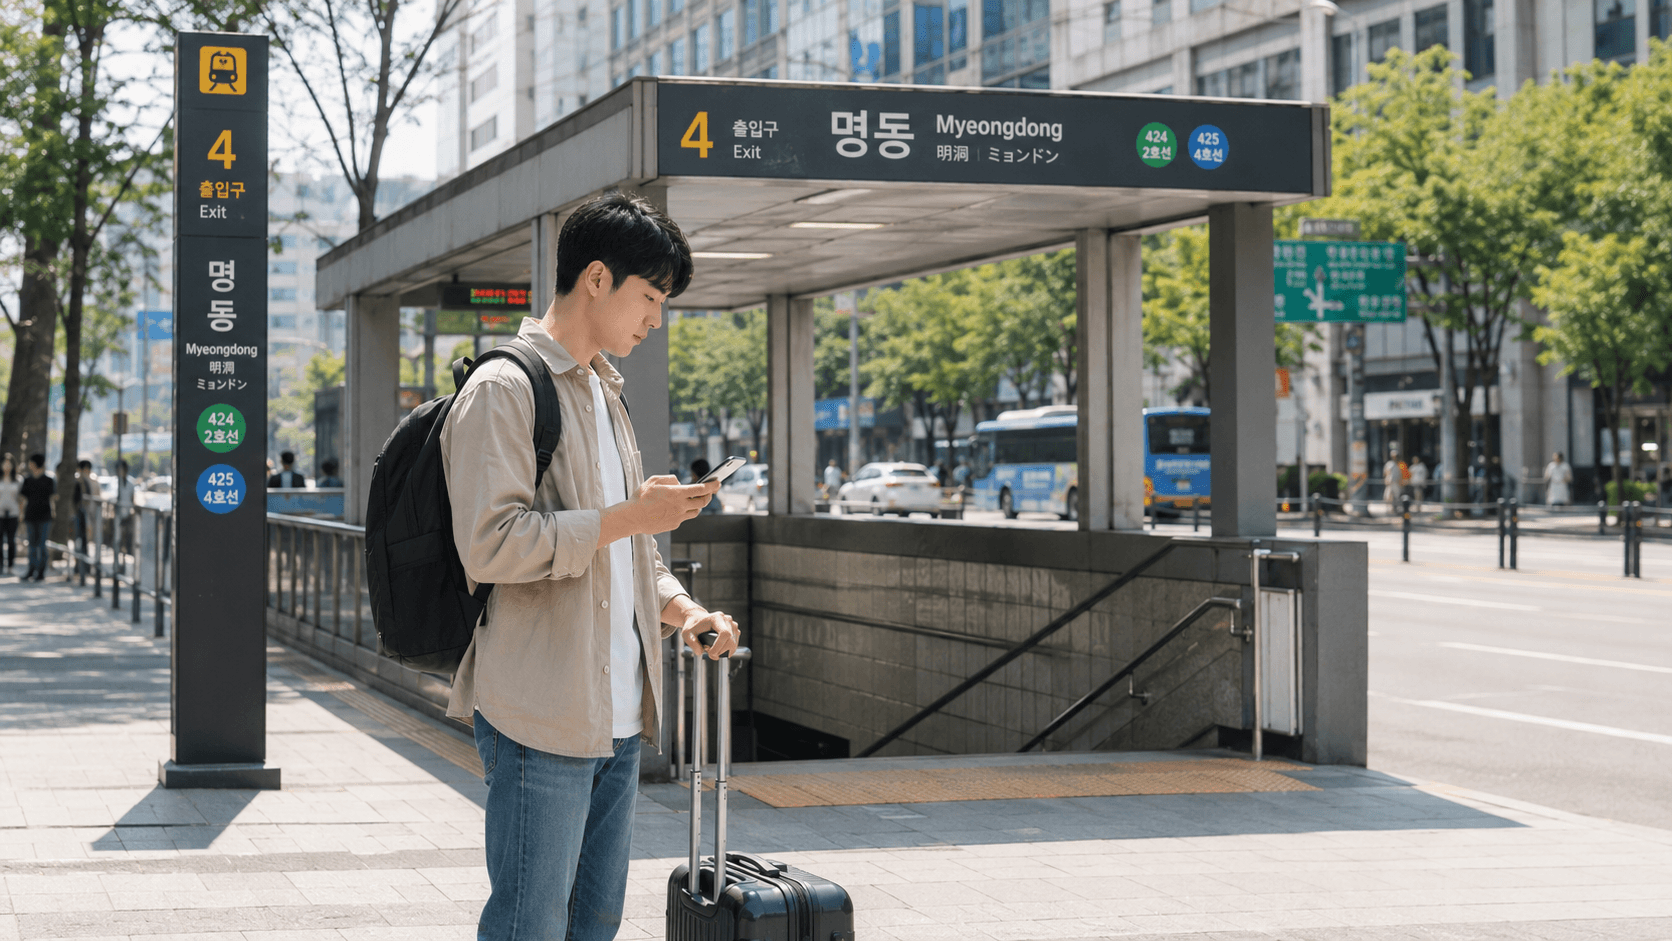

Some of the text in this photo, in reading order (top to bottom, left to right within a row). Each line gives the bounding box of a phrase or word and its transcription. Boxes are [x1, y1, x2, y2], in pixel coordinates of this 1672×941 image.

[680, 111, 714, 158] 4
[732, 119, 779, 138] 출입구
[831, 109, 915, 160] 명동
[936, 114, 1063, 142] Myeongdong
[1145, 130, 1168, 143] 424
[1197, 132, 1219, 145] 425
[207, 129, 236, 169] 4
[733, 145, 761, 159] Exit
[988, 147, 1059, 164] ミョンドン
[1142, 146, 1171, 160] 2호선
[1194, 147, 1223, 162] 4호선
[199, 180, 246, 199] 출입구
[200, 204, 227, 218] Exit
[207, 260, 237, 332] 명동
[186, 343, 258, 358] Myeongdong
[197, 378, 247, 390] ミョンドン
[208, 412, 234, 426] 424
[204, 429, 239, 444] 2호선
[208, 472, 234, 486] 425
[203, 489, 239, 505] 4호선
